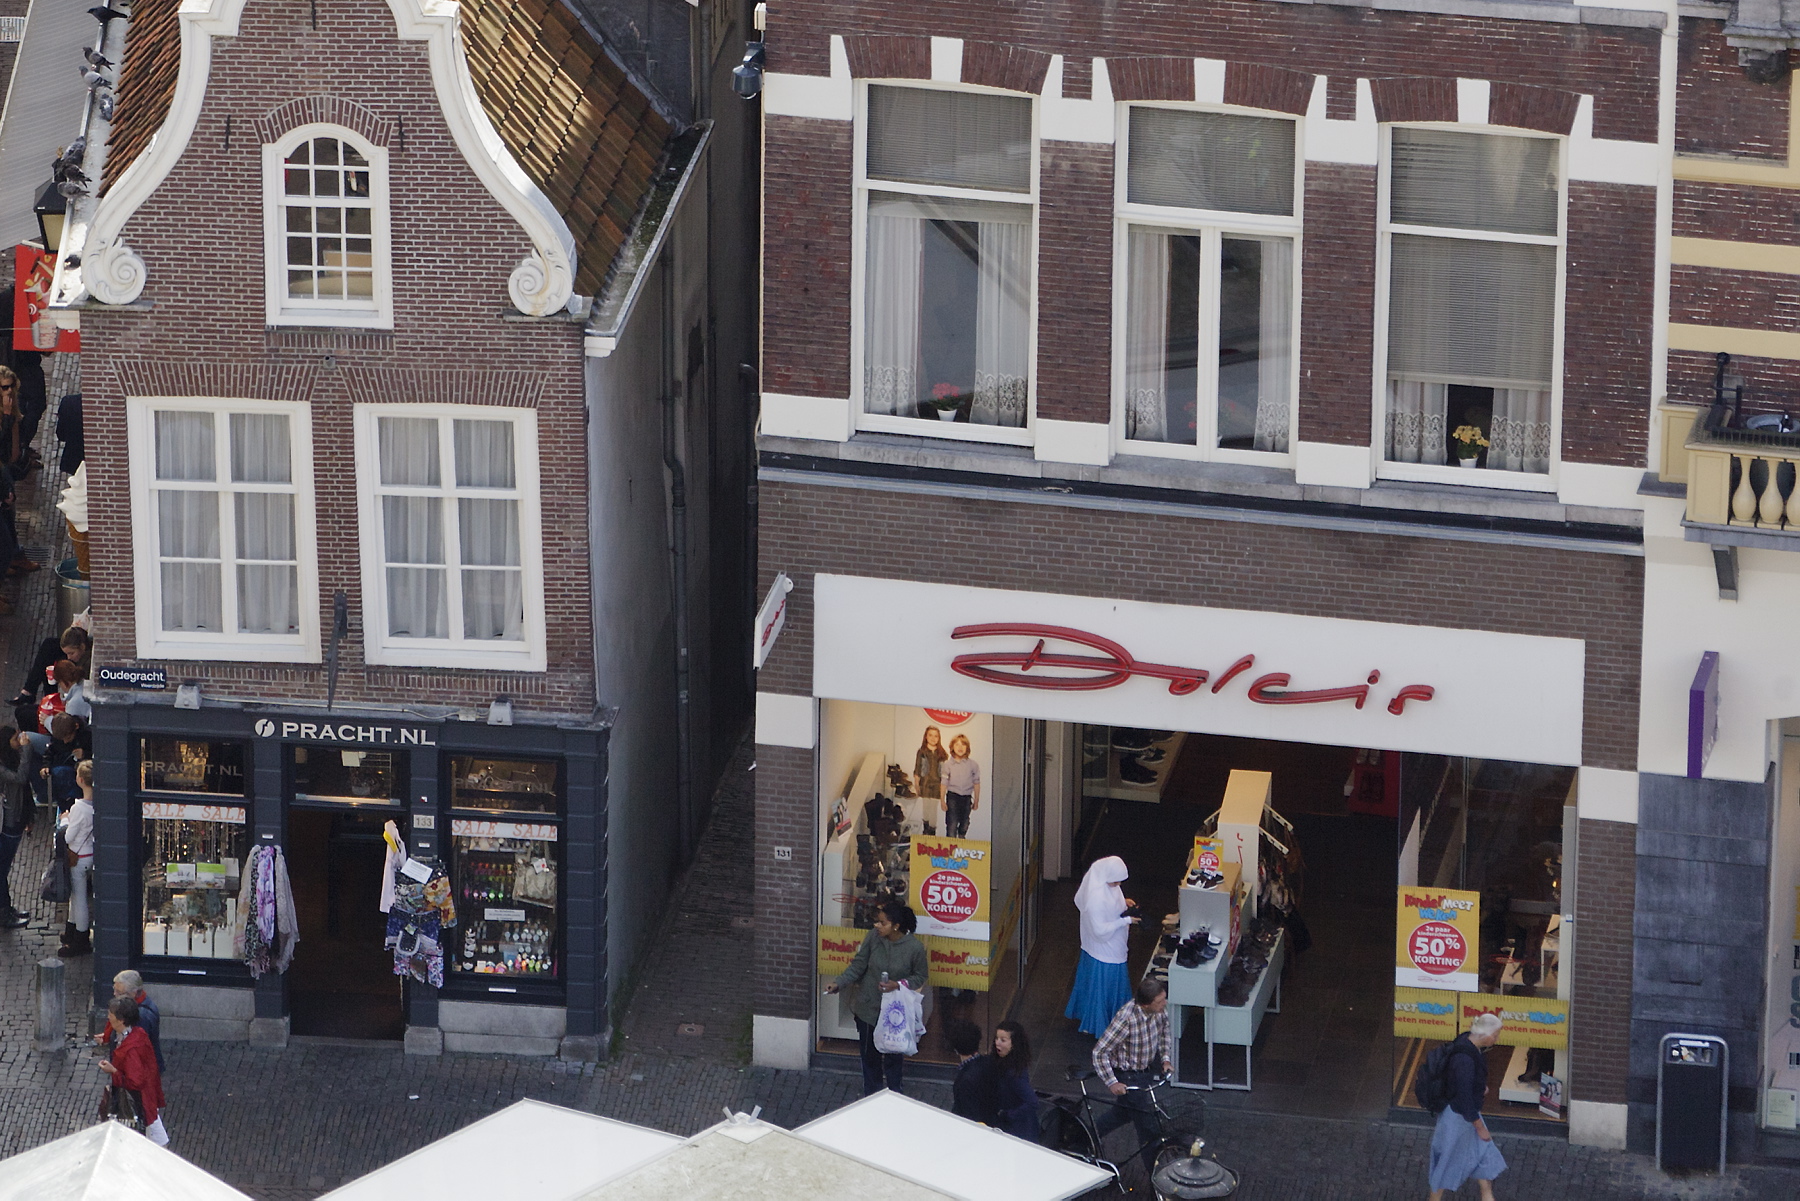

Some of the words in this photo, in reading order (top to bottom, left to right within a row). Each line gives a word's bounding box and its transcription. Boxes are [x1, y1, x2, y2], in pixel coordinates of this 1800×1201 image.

[100, 669, 165, 683] Oudegracht
[282, 721, 436, 747] PRACHT.NL
[144, 760, 243, 777] PRACT.NL
[143, 802, 186, 818] SALE
[201, 805, 245, 821] SALE
[416, 816, 432, 827] 133
[451, 819, 498, 836] SALE
[512, 823, 557, 839] SALE
[776, 849, 790, 857] 131
[929, 879, 970, 887] kinderschoenen
[927, 885, 972, 905] 50%
[1417, 930, 1459, 938] kinderschoenen
[1415, 937, 1461, 957] 50%
[955, 968, 963, 976] je
[965, 969, 988, 977] voete
